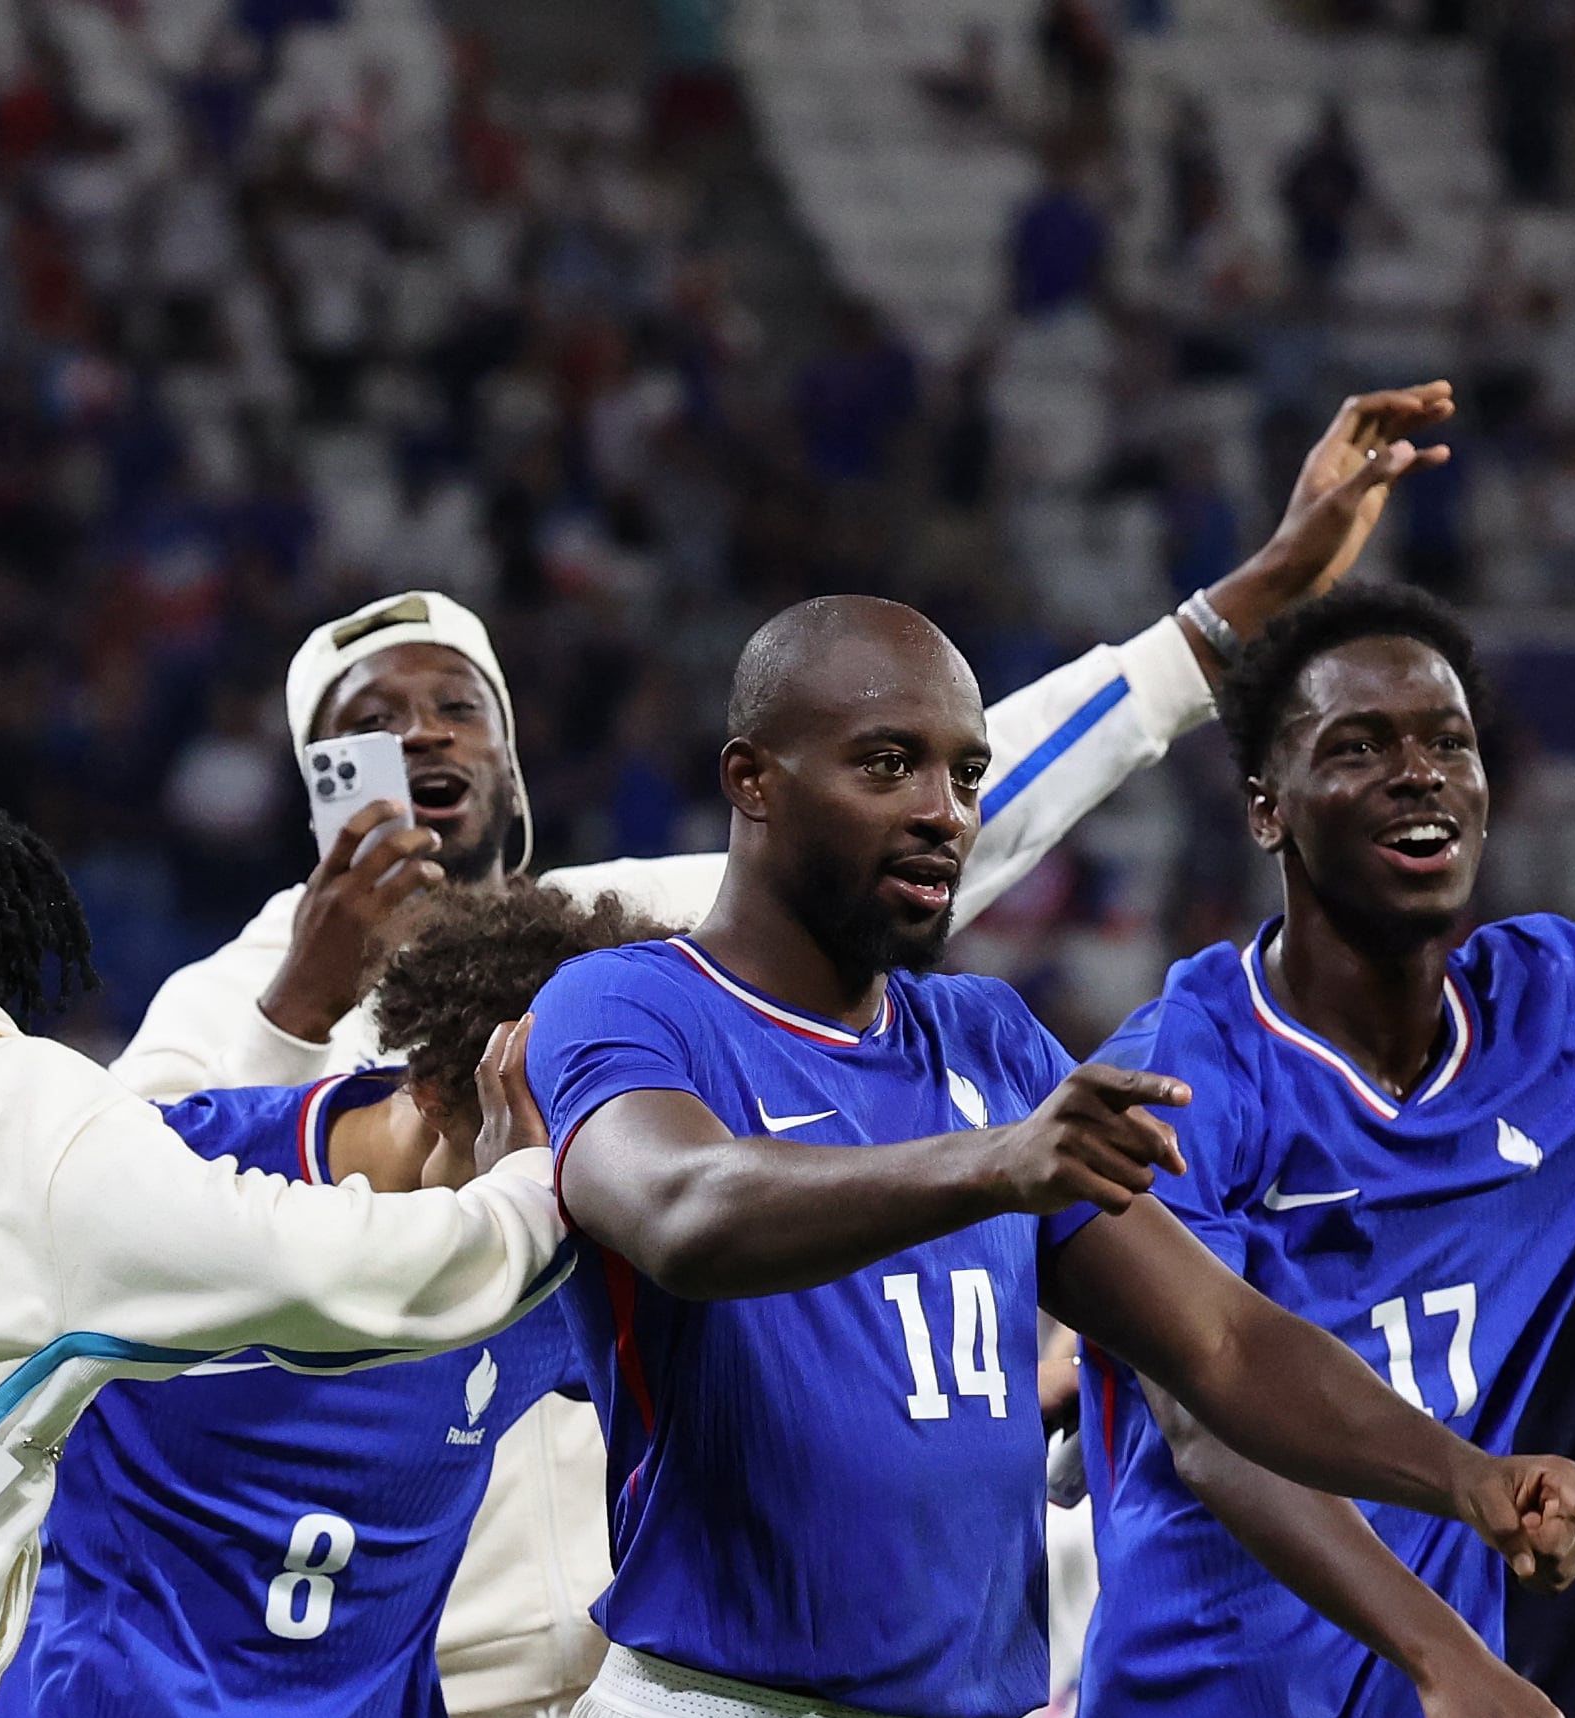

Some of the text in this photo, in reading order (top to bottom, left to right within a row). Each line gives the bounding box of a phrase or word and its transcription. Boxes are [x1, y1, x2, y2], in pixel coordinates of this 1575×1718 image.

[883, 1269, 1008, 1419] 14
[1371, 1282, 1478, 1418] 17
[445, 1425, 486, 1445] FRANCE
[265, 1513, 356, 1640] 8
